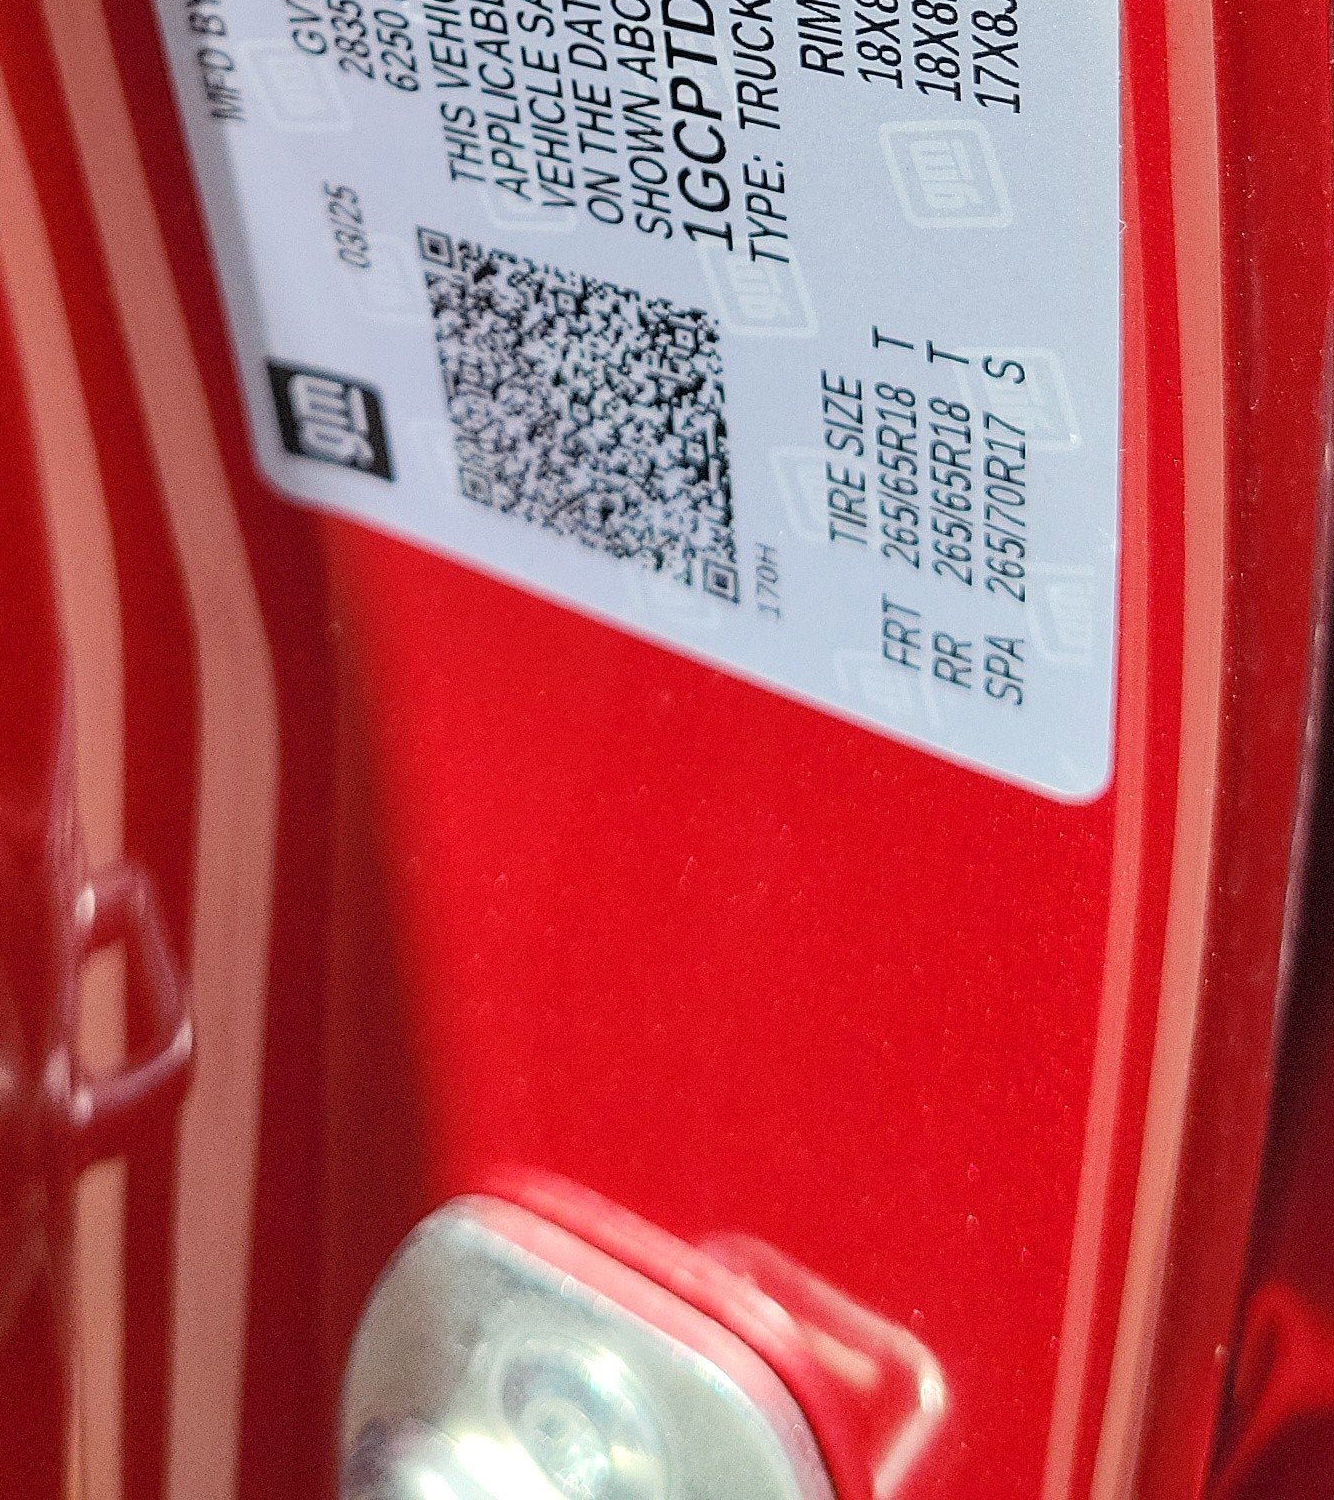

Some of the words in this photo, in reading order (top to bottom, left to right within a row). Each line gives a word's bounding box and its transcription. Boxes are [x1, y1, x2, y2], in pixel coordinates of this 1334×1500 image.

[373, 10, 420, 92] 6250
[440, 103, 486, 183] THIS
[520, 45, 577, 209] VEHICLE
[572, 78, 618, 155] THE
[581, 167, 624, 225] ON
[620, 89, 674, 240] SHOWN
[323, 182, 372, 270] 03/25
[742, 155, 790, 263] TYPE:
[871, 325, 915, 350] T
[926, 340, 971, 365] T
[981, 354, 1026, 385] S
[820, 369, 866, 457] SIZE
[824, 462, 868, 546] TIRE
[874, 381, 921, 569] 265/65R18
[927, 395, 975, 587] 265/65R18
[982, 411, 1026, 603] 265/70R17
[755, 542, 781, 619] 170H
[880, 592, 922, 671] FRT
[931, 631, 973, 689] RR
[982, 633, 1026, 706] SPA
